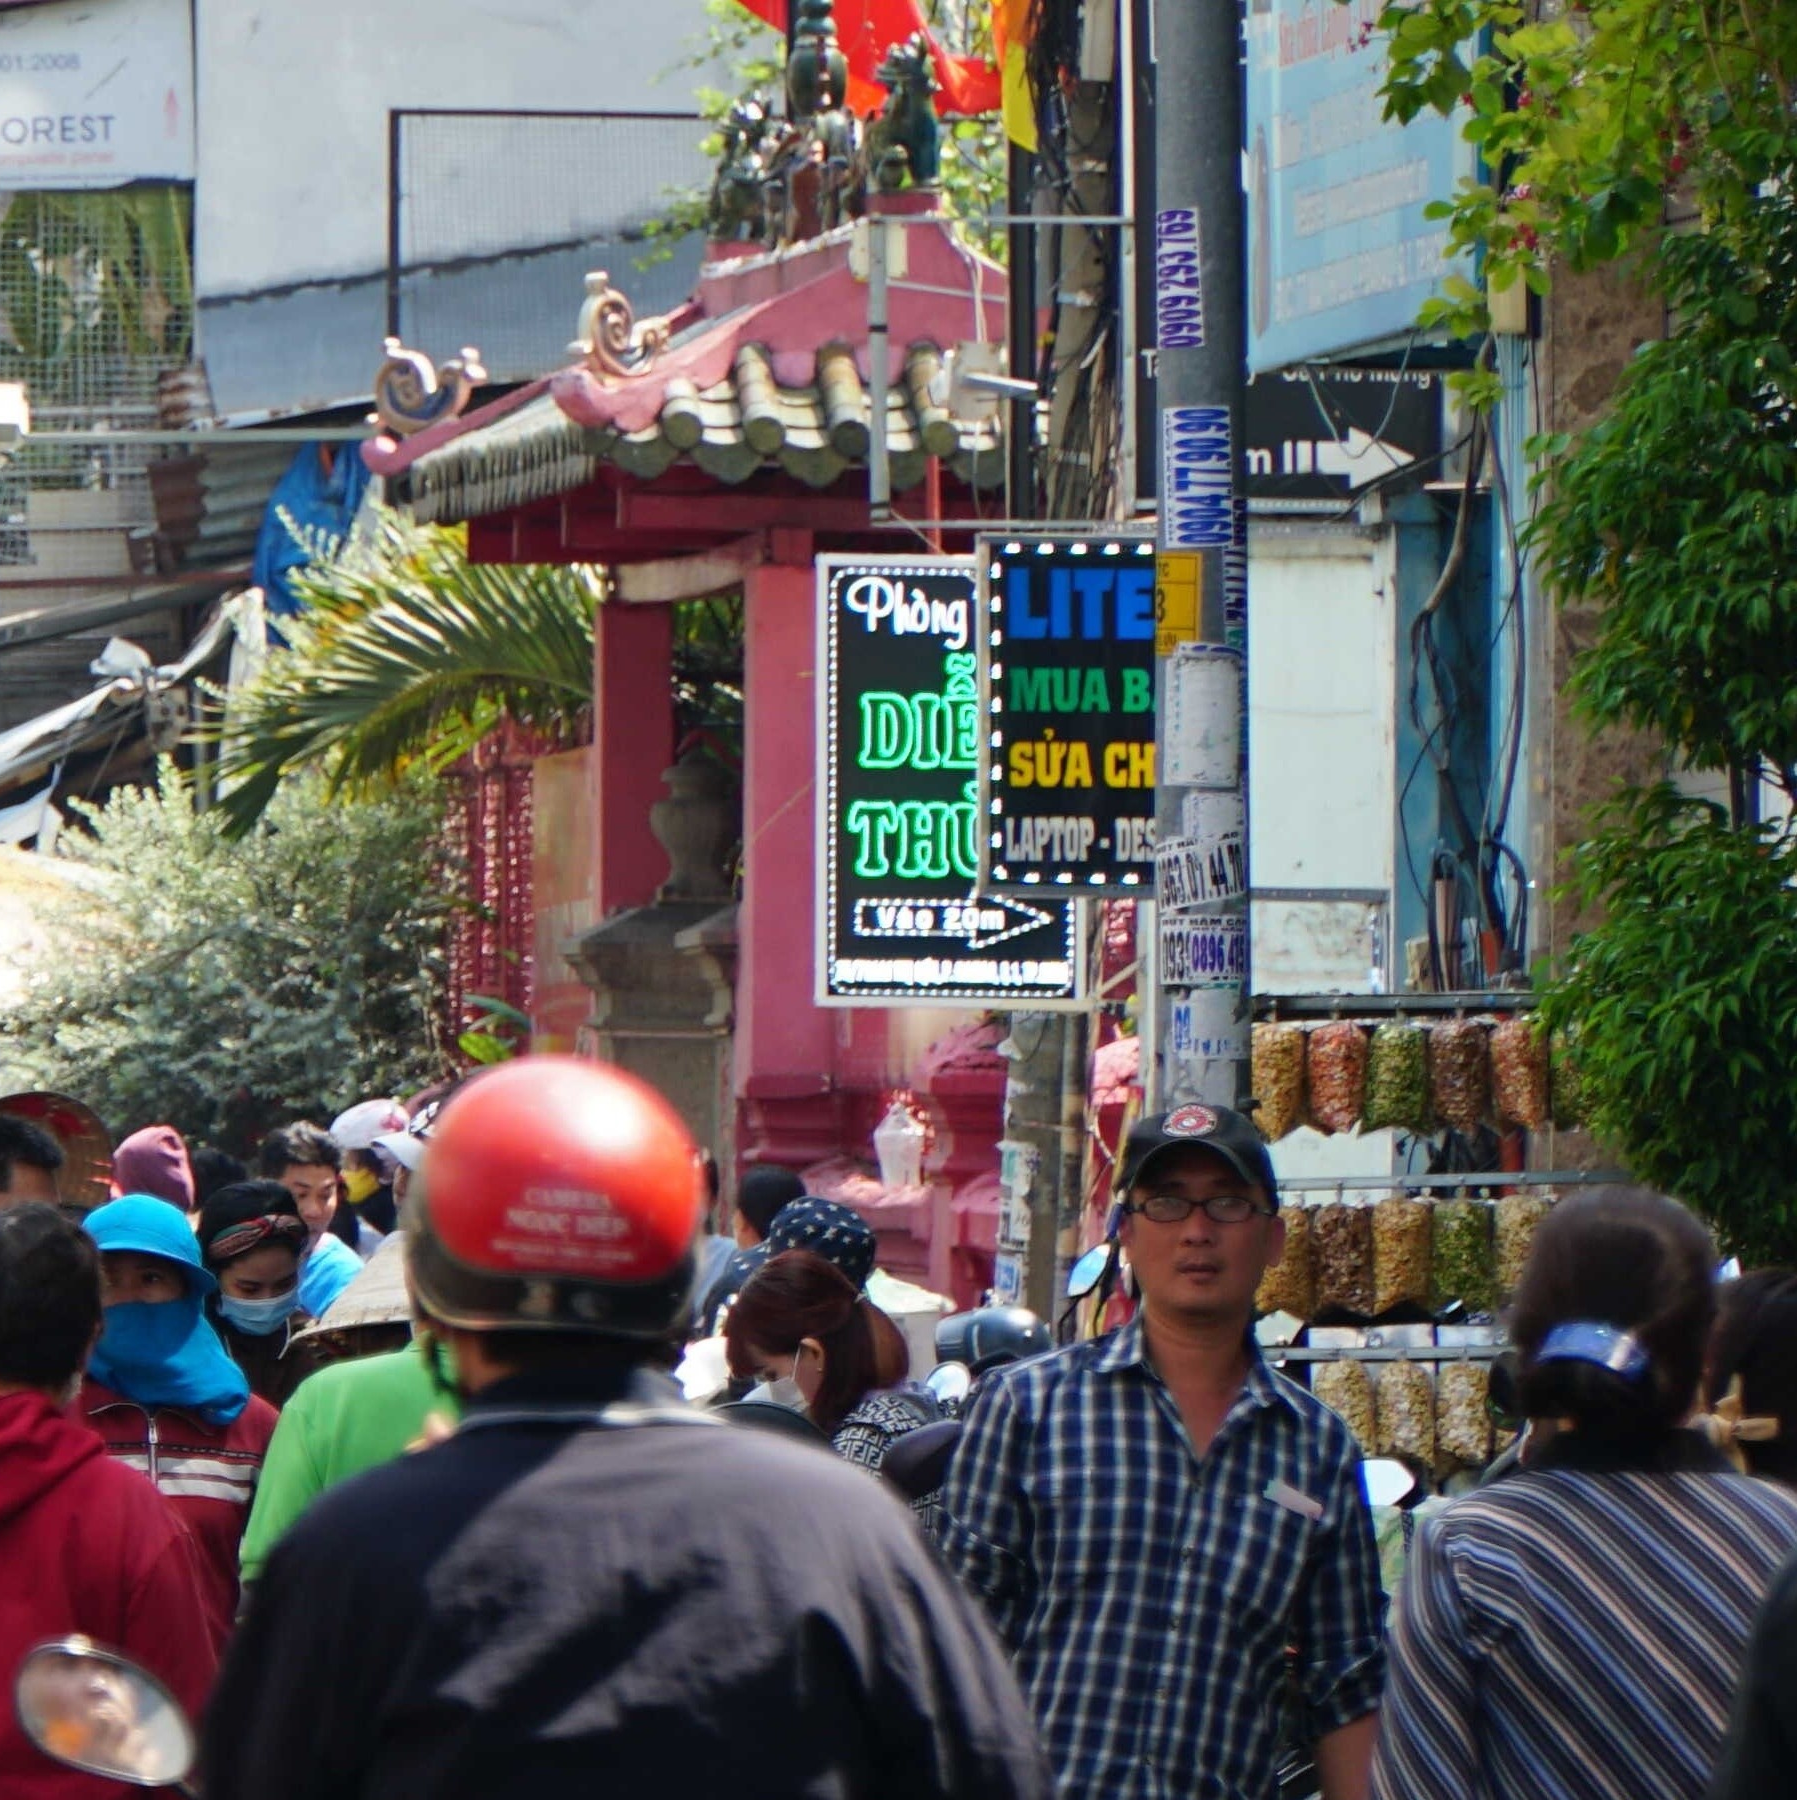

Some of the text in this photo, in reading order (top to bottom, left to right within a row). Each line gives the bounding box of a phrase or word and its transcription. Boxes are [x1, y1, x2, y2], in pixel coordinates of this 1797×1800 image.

[1157, 210, 1203, 350] 0909.293.769
[1174, 408, 1233, 545] 0904.77.90.90
[846, 576, 968, 649] Phòng
[1009, 567, 1155, 640] LITE
[1009, 667, 1155, 714] MUA B
[1009, 727, 1094, 788] SỬA
[1006, 817, 1096, 862] LAPTOP
[943, 907, 1005, 931] 20m
